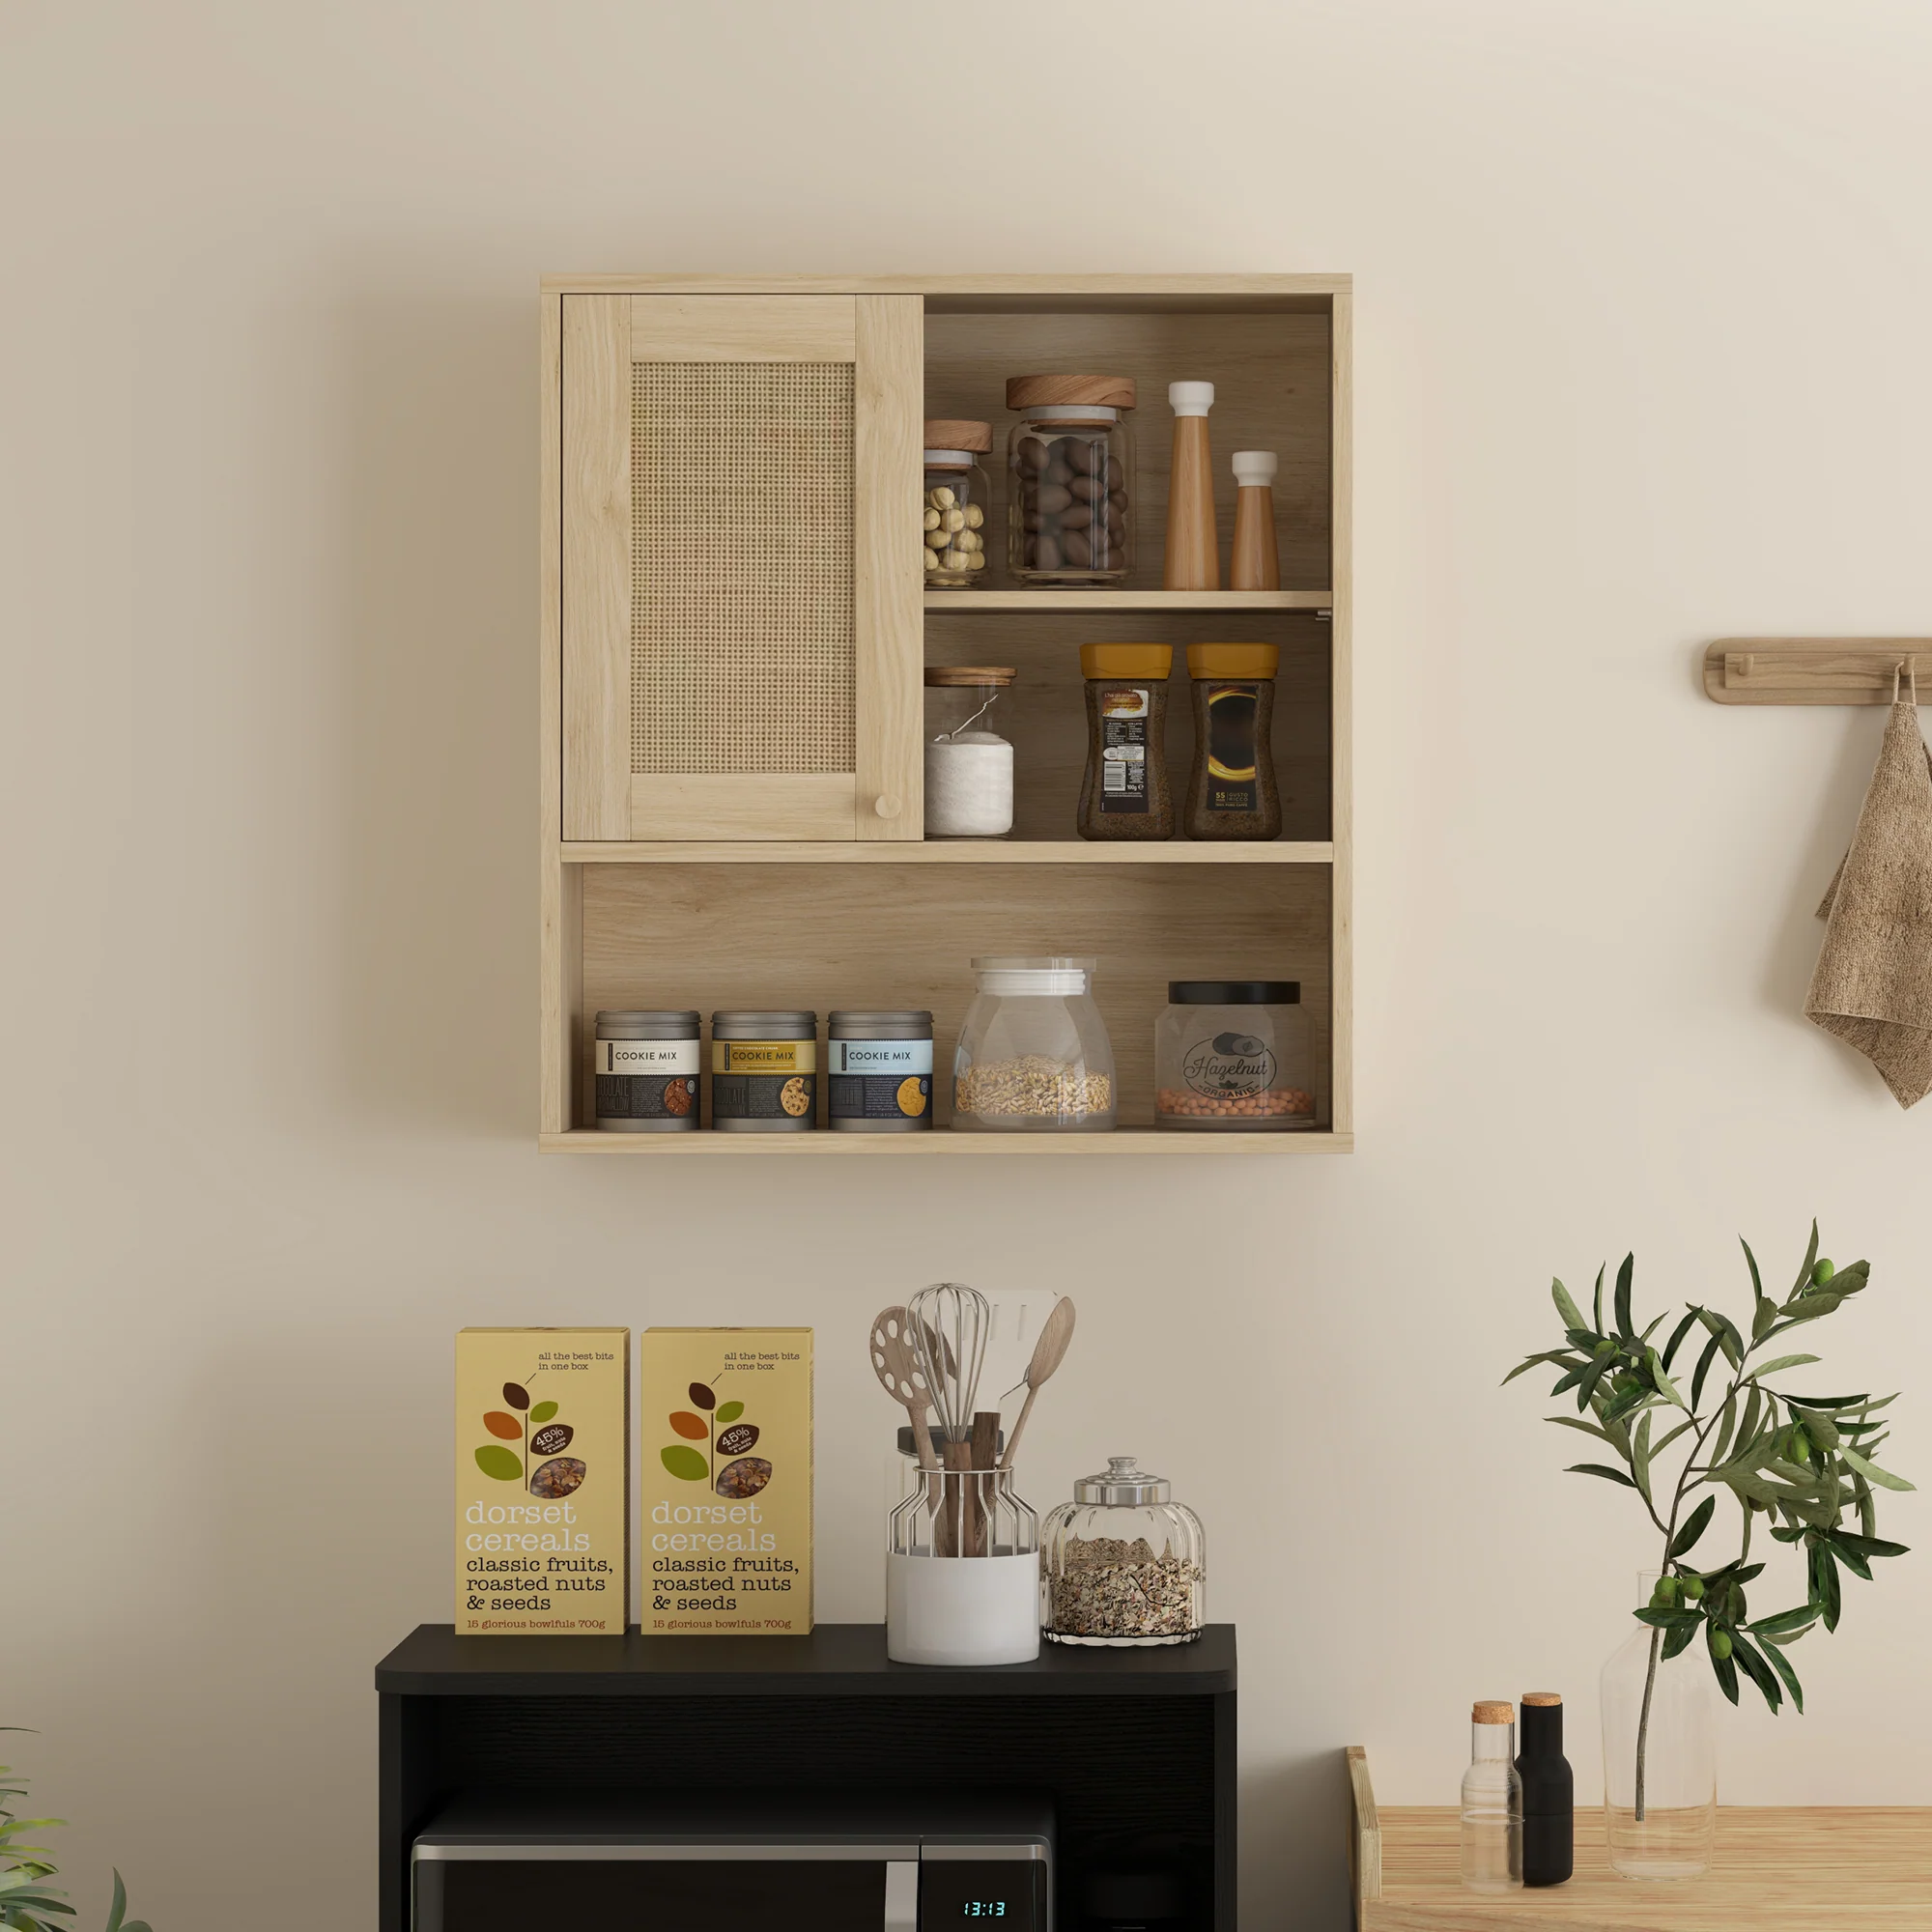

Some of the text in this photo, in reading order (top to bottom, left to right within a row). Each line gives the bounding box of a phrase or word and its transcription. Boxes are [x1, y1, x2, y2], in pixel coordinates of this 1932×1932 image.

[614, 1051, 677, 1061] COOKIE MIX
[732, 1051, 794, 1061] COOKIE MIX
[849, 1051, 911, 1061] COOKIE MIX
[1183, 1056, 1267, 1080] Hazelnut
[538, 1351, 614, 1360] all the best bits
[724, 1351, 801, 1360] all the best bits
[538, 1362, 549, 1371] in
[571, 1362, 588, 1371] box
[724, 1362, 735, 1371] in
[756, 1362, 775, 1371] box
[536, 1427, 564, 1446] 45%
[722, 1427, 751, 1446] 45%
[466, 1500, 577, 1524] dorset
[651, 1500, 763, 1524] dorset
[466, 1528, 590, 1551] cereals
[651, 1528, 777, 1551] cereals
[467, 1556, 613, 1575] classic fruits,
[652, 1556, 800, 1575] classic fruits,
[466, 1576, 606, 1591] roasted nuts
[651, 1576, 792, 1591] roasted nuts
[467, 1595, 551, 1610] & seeds
[652, 1595, 737, 1610] & seeds
[467, 1619, 607, 1630] 15 glorious bowlfuls 700g
[652, 1619, 793, 1630] 15 glorious bowlfuls 700g
[964, 1901, 1006, 1917] 13:13
